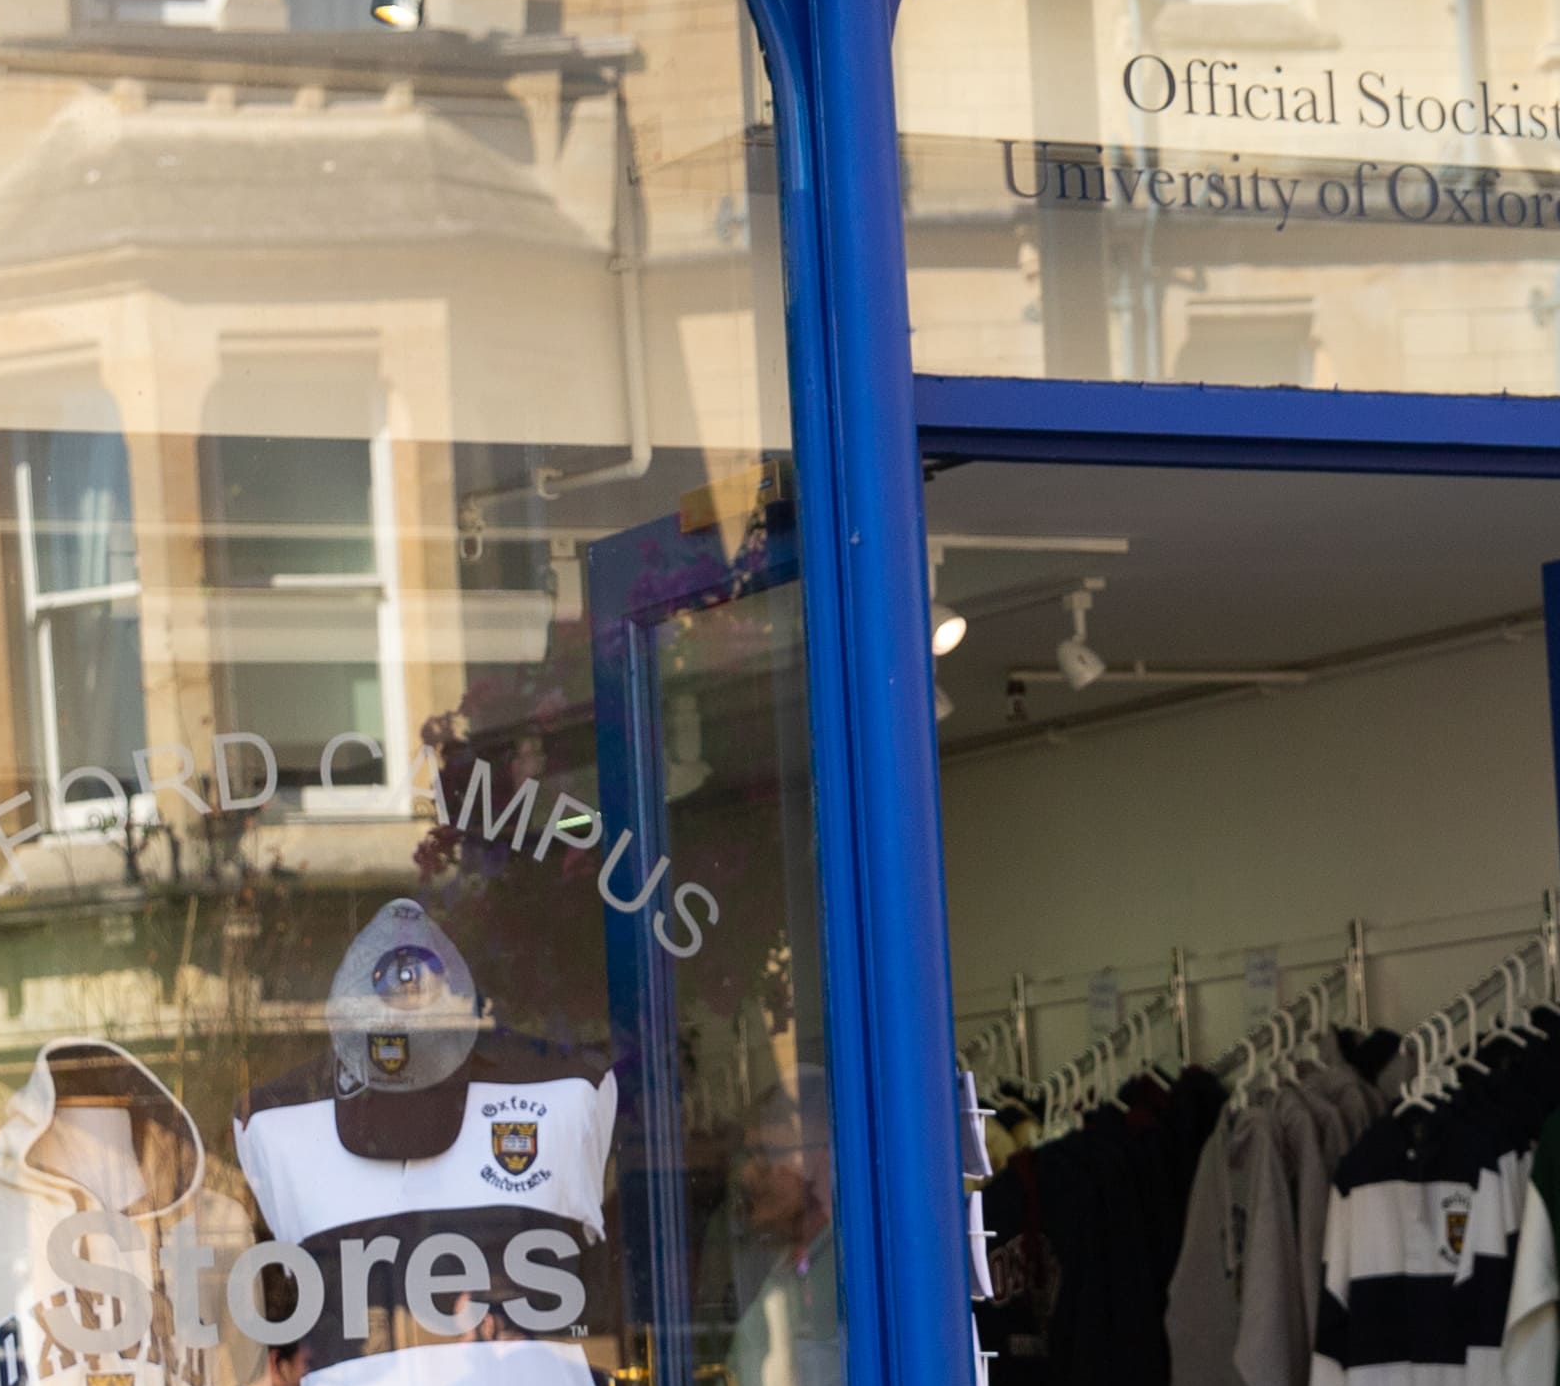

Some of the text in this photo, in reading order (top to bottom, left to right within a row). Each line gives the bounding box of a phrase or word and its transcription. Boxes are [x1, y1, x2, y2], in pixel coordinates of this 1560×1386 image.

[1122, 53, 1340, 126] Official
[996, 139, 1300, 232] University
[1318, 161, 1377, 217] of
[320, 732, 720, 958] CAMPUS
[481, 1095, 548, 1119] Oxford
[46, 1210, 586, 1354] Stores
